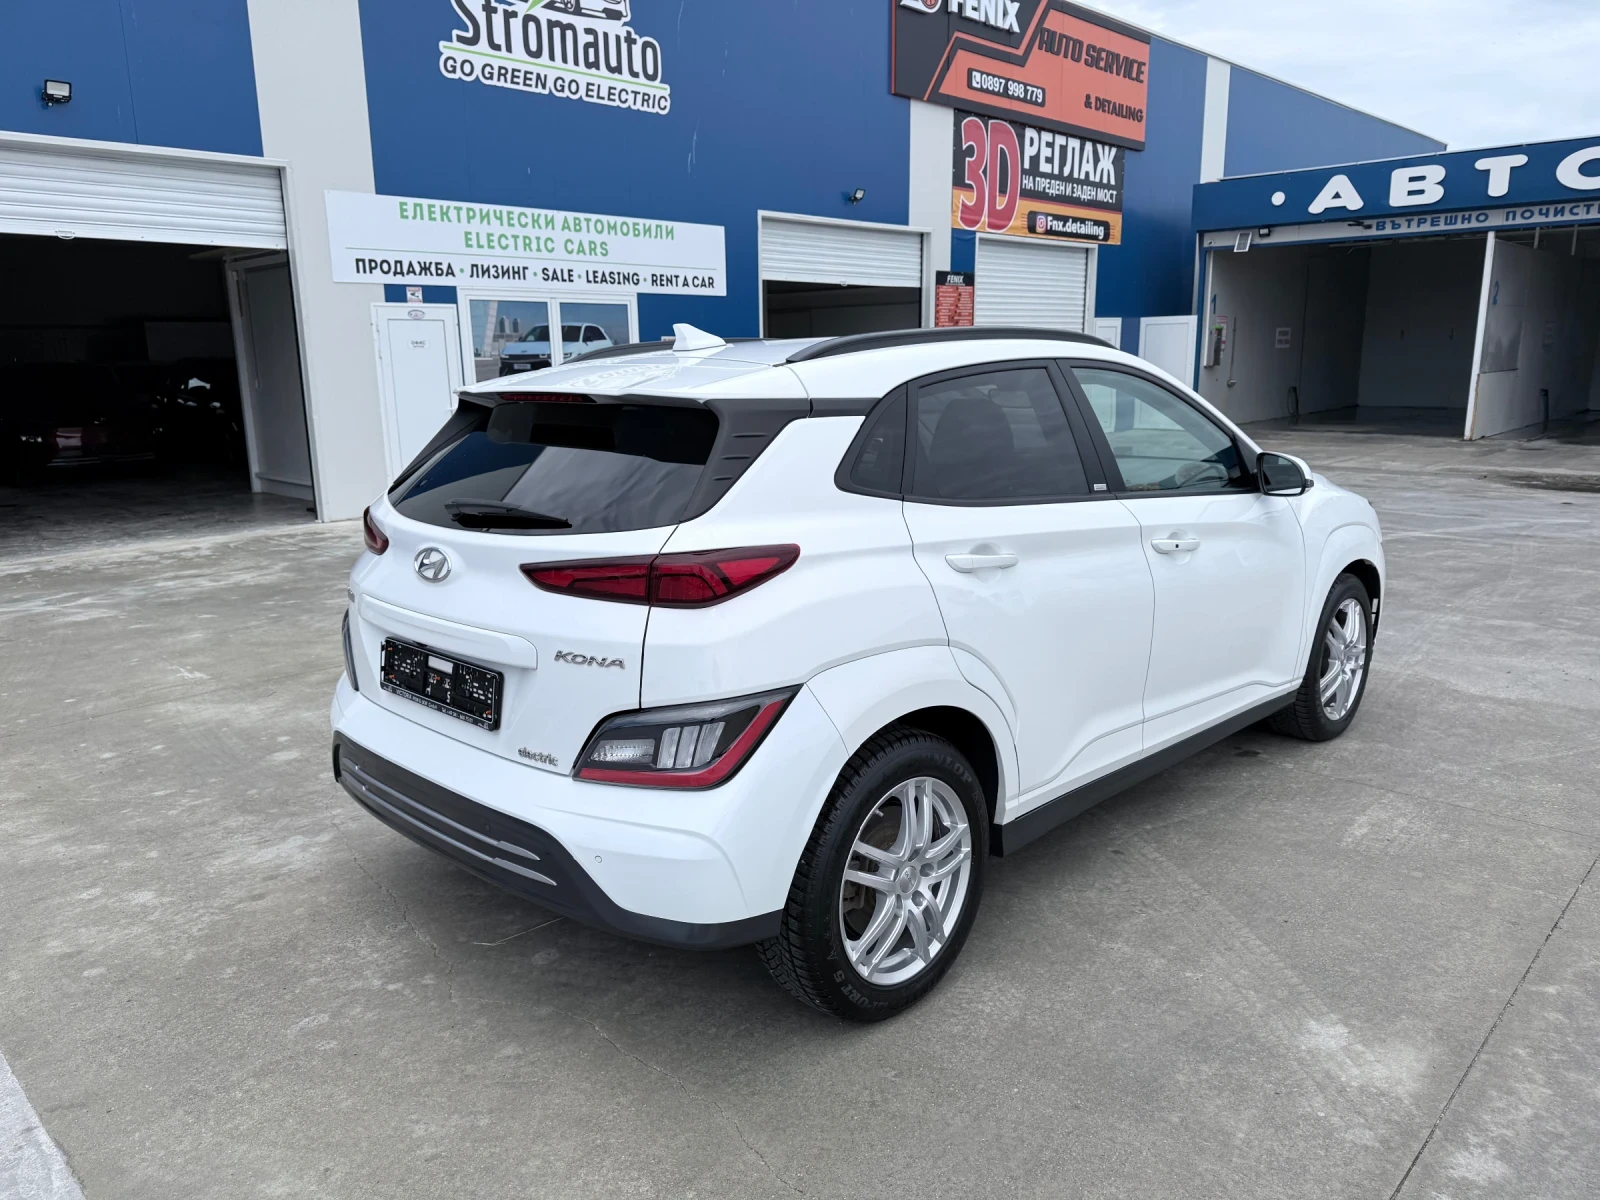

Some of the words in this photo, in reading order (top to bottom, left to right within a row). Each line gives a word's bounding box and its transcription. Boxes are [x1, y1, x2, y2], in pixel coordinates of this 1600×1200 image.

[1038, 26, 1084, 63] AUTO
[1084, 43, 1147, 84] SERVICE
[443, 56, 475, 76] GO
[481, 63, 548, 90] GREEN
[553, 76, 580, 96] GO
[585, 82, 669, 111] ELECTRIC
[981, 73, 1006, 93] 0897
[1007, 80, 1025, 99] 998
[1026, 86, 1043, 103] 779
[1084, 93, 1093, 110] &
[1094, 95, 1144, 123] DETAILING
[1023, 127, 1118, 186] РЕГЛАЖ
[958, 116, 1021, 233] 3D
[1022, 174, 1034, 190] НА
[1035, 176, 1066, 197] ПРЕДЕН
[1065, 183, 1072, 197] И
[1072, 184, 1097, 203] ЗАДЕН
[1096, 188, 1117, 204] МОСТ
[398, 201, 555, 231] ЕЛЕКТРИЧЕСКИ
[561, 215, 675, 241] АВТОМОБИЛИ
[1047, 215, 1104, 240] Fnx.detailing
[1375, 212, 1489, 232] ВЪТРЕШНО
[1505, 202, 1600, 222] ПОЧИСТ
[463, 231, 555, 253] ELECTRIC
[563, 238, 609, 257] CARS
[355, 258, 456, 278] ПРОДАЖБА
[469, 263, 529, 281] ЛИЗИНГ
[541, 267, 574, 283] SALE
[586, 269, 640, 286] LEASING
[651, 273, 680, 288] RENT
[682, 275, 690, 288] A
[691, 276, 715, 289] CAR
[554, 649, 626, 670] KONA
